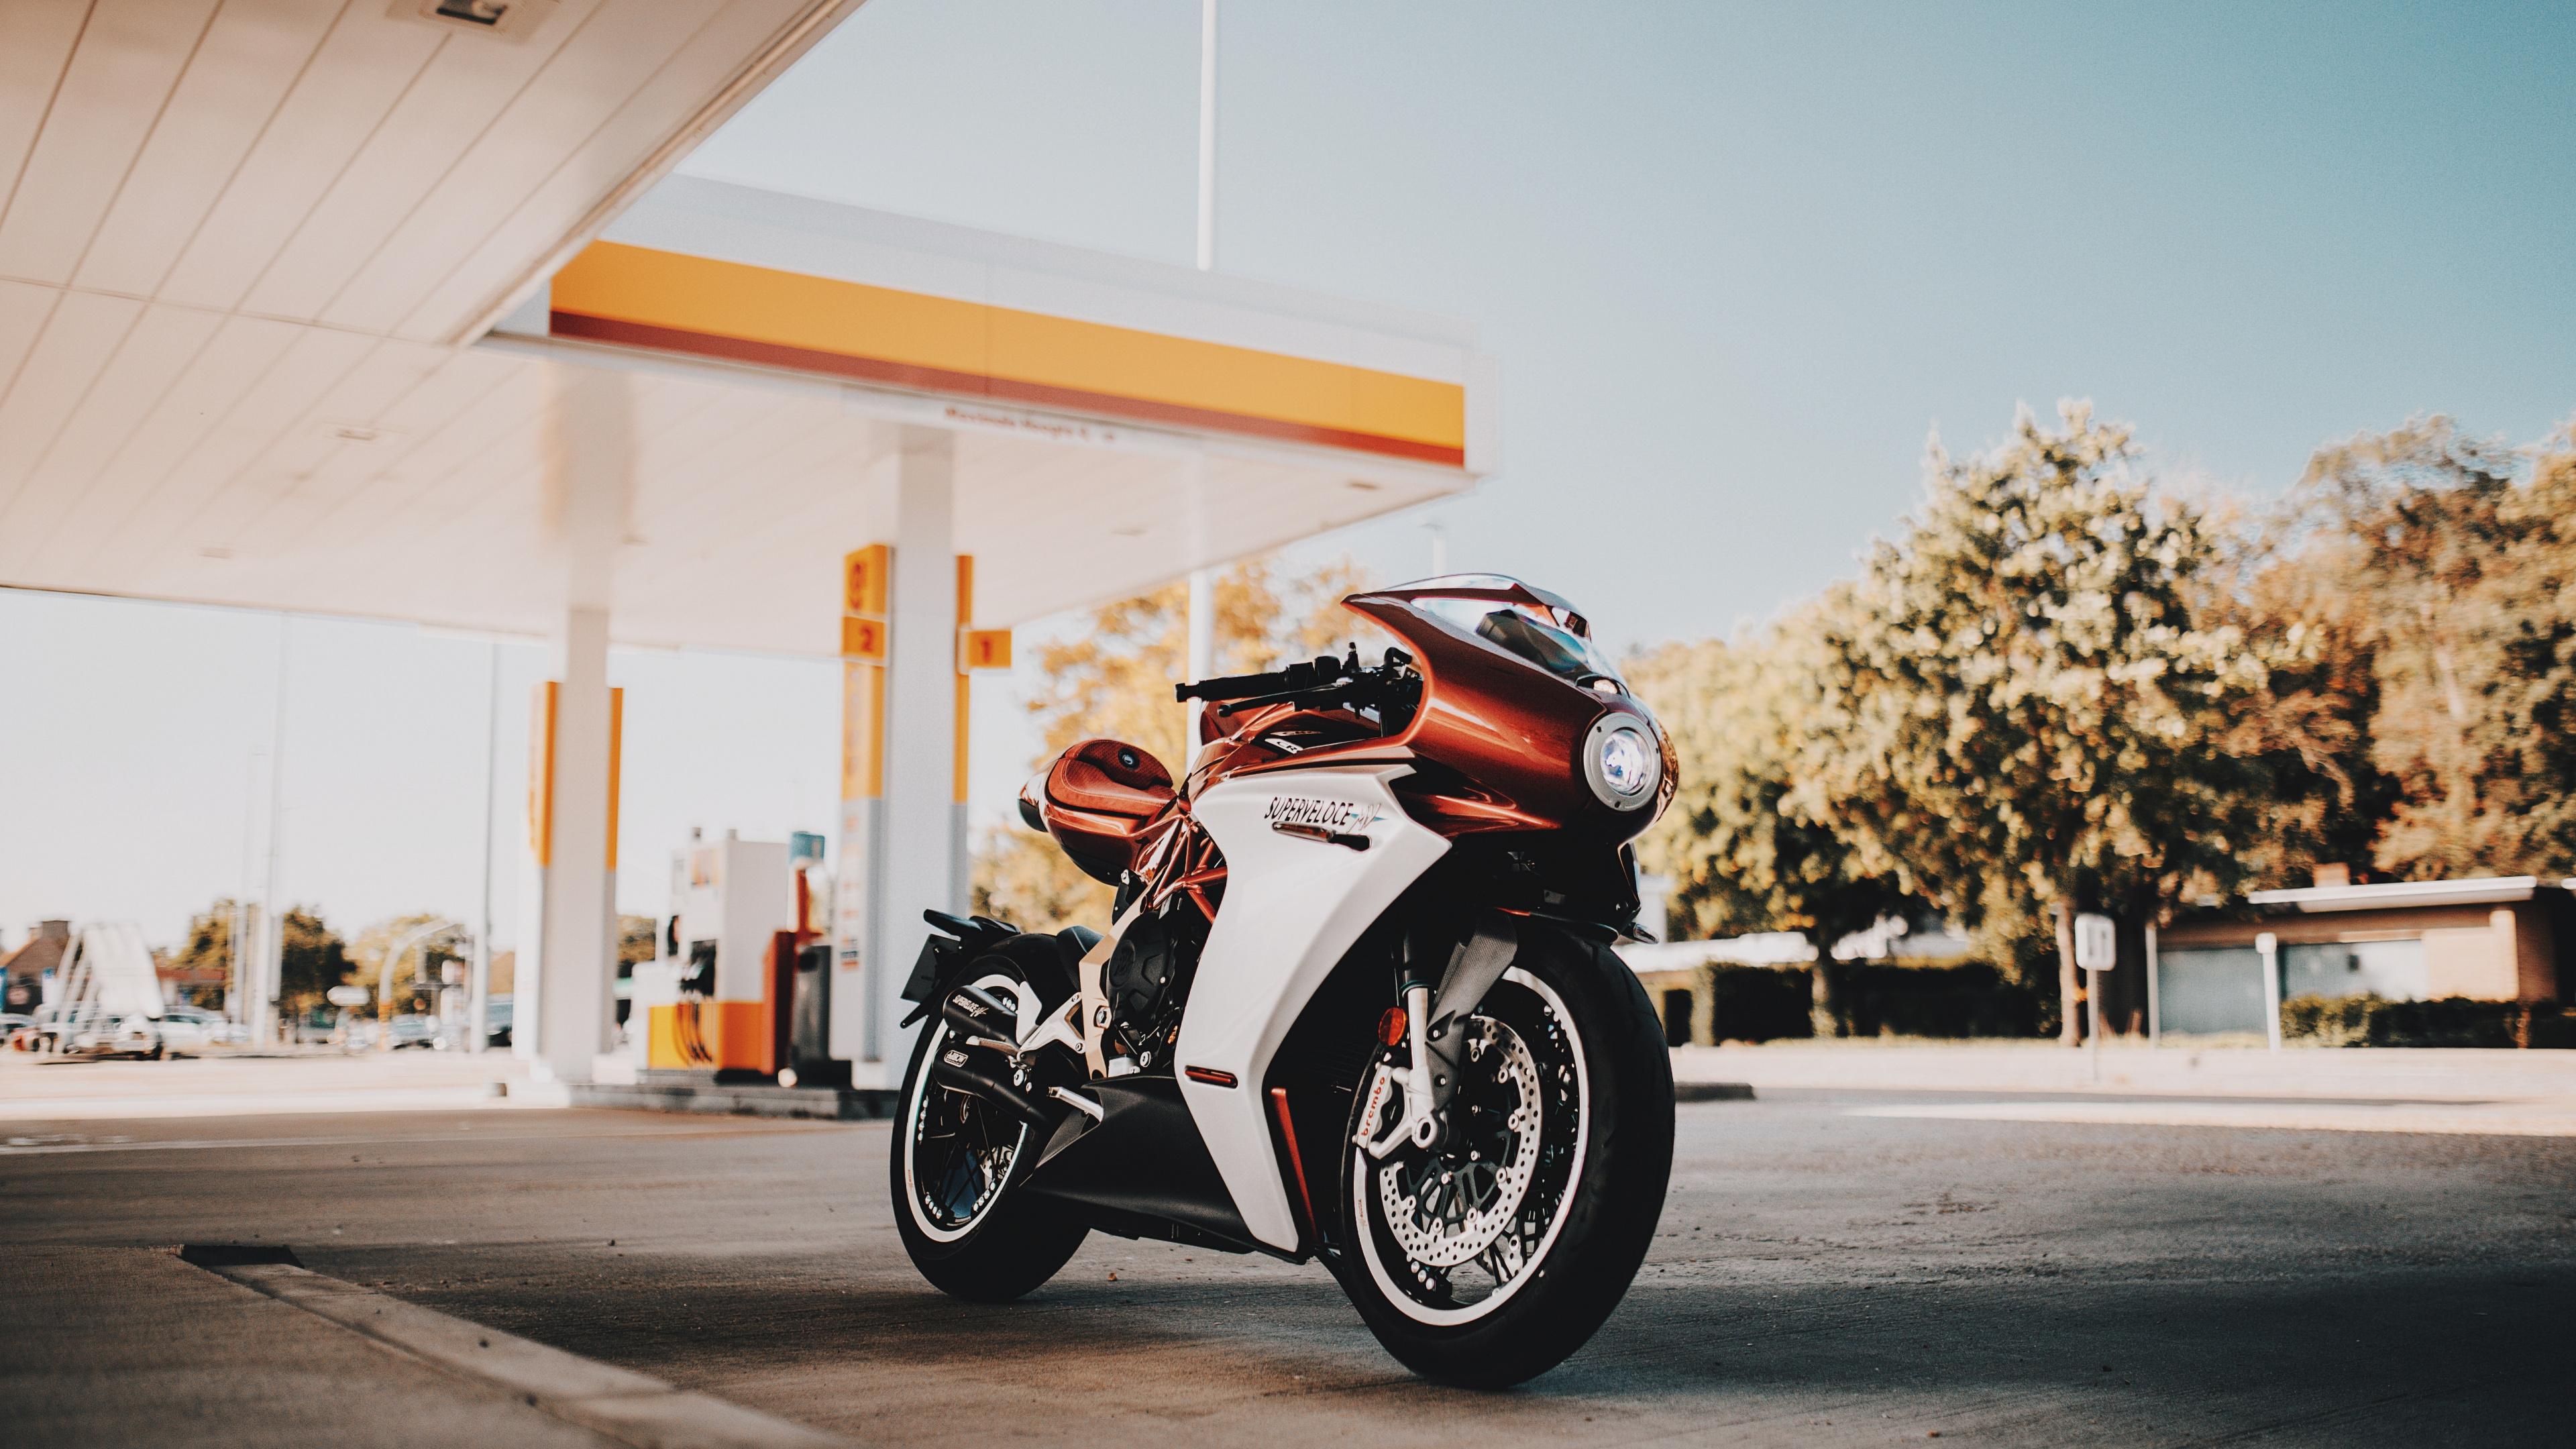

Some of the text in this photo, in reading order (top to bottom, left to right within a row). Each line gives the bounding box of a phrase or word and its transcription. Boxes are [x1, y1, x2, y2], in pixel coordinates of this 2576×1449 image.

[861, 623, 874, 653] 2
[980, 637, 991, 662] 1
[1277, 741, 1299, 752] CR
[1264, 796, 1354, 826] SUPERVELOCE
[1360, 1077, 1385, 1136] brembo
